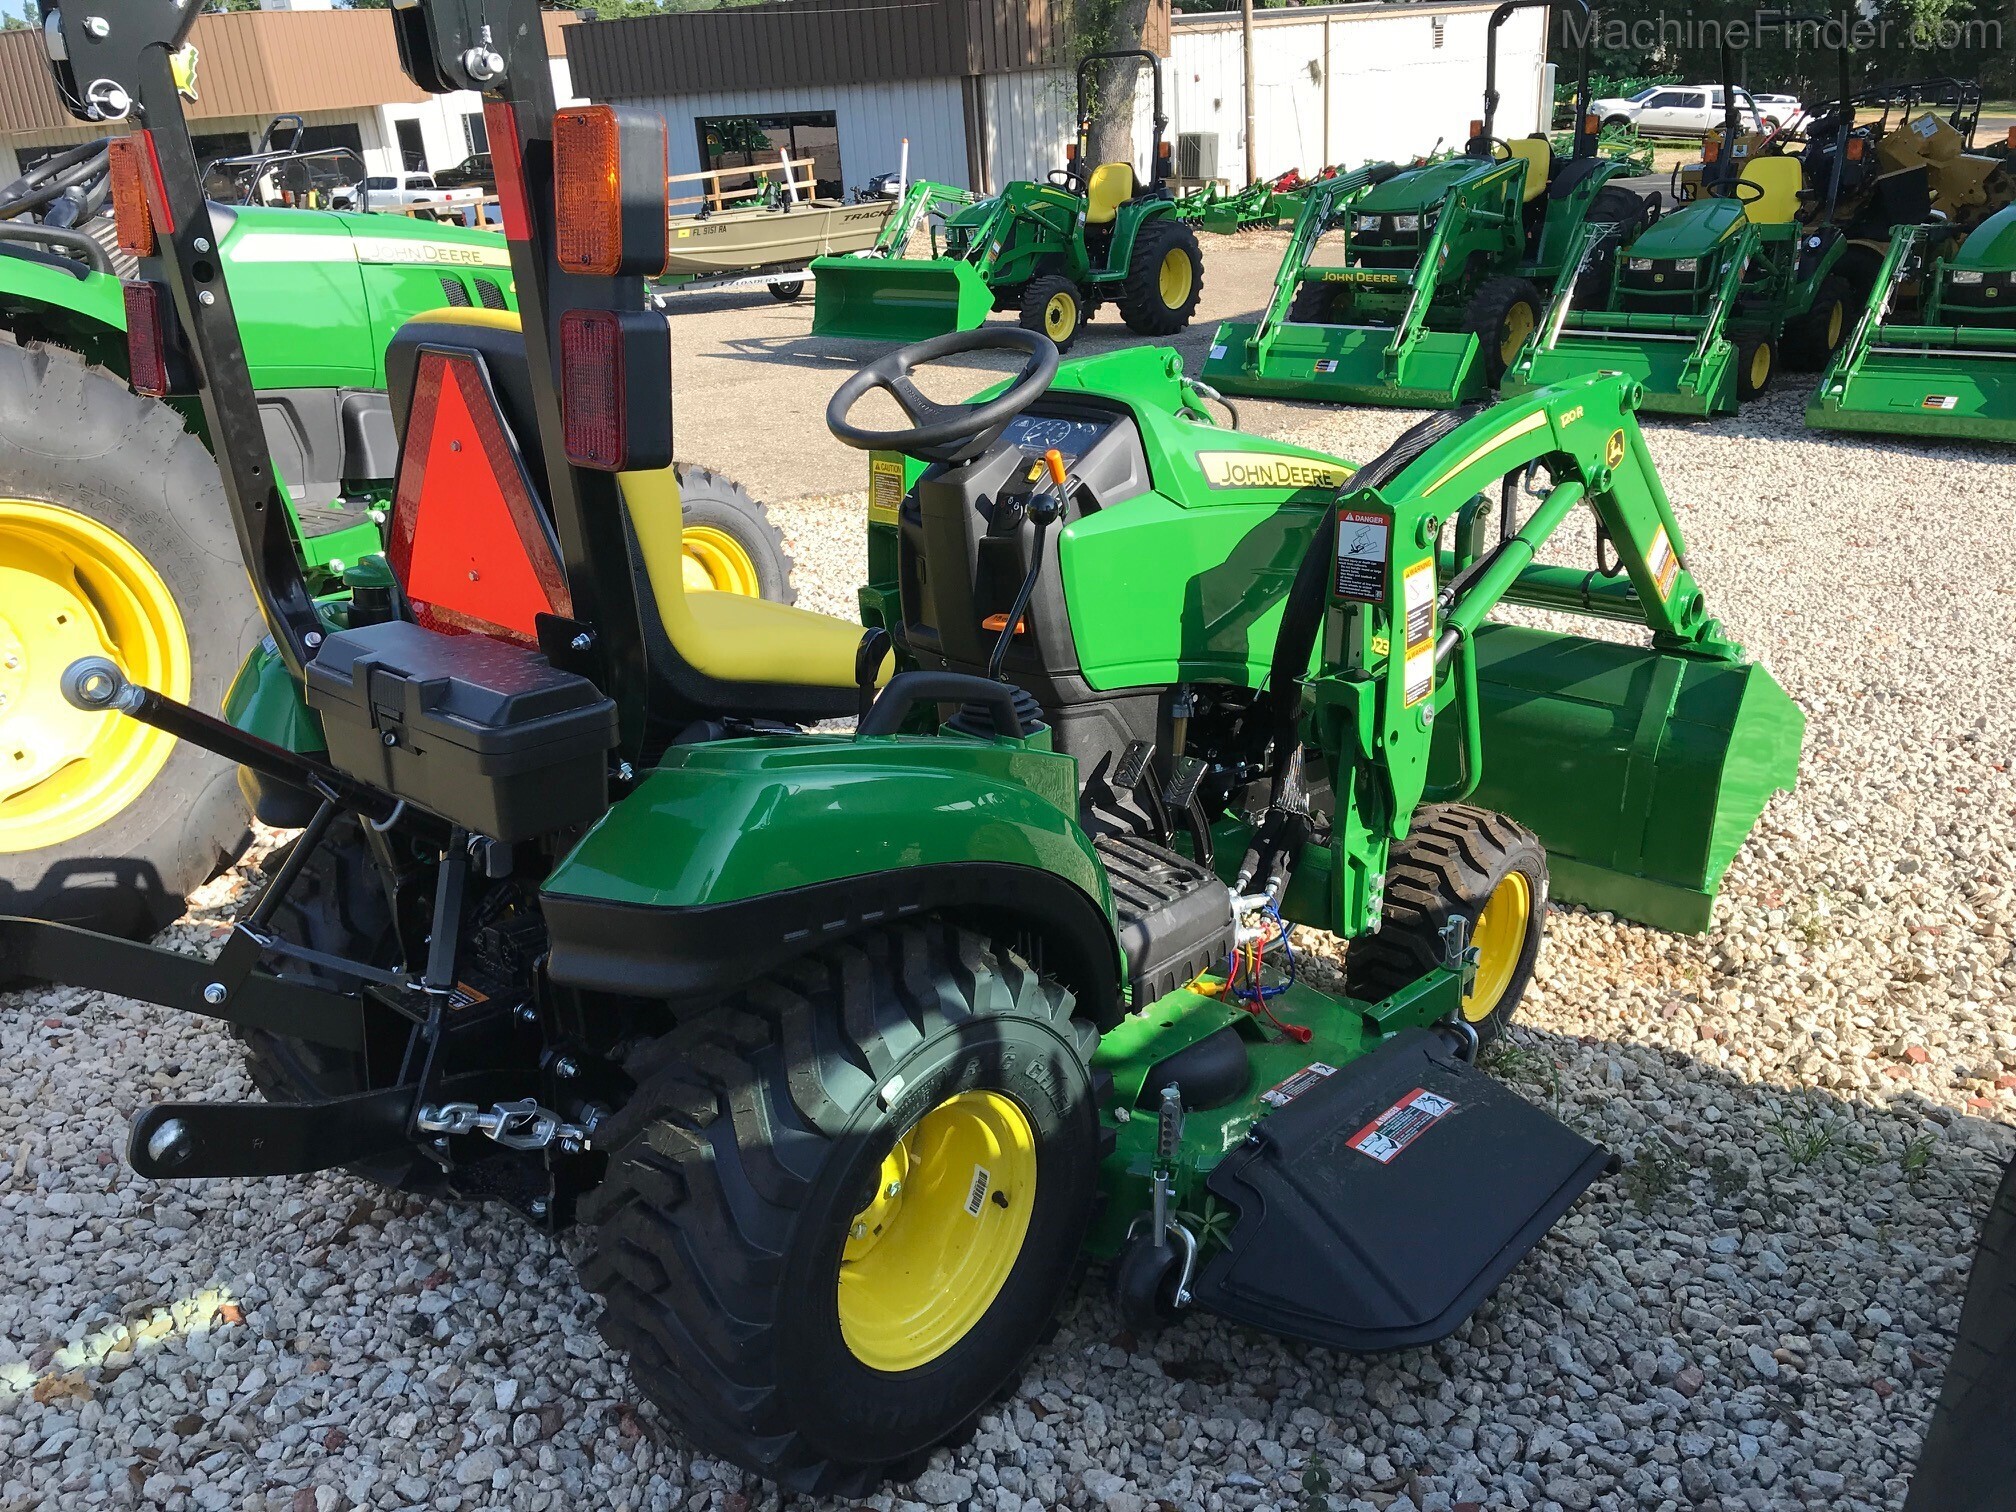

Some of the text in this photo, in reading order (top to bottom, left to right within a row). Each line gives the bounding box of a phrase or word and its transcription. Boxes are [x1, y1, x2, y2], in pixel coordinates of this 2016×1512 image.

[844, 209, 899, 221] TRACKE
[719, 225, 727, 233] RA
[372, 244, 482, 262] JOHN DEERE
[1322, 272, 1398, 282] JOHN DEERE
[881, 463, 901, 474] CAUTION
[1222, 462, 1334, 486] JOHN DEERE
[1355, 515, 1383, 524] DANGER
[1409, 560, 1432, 576] WARNING
[1410, 641, 1433, 658] WARNING
[1379, 1106, 1401, 1122] DANGER
